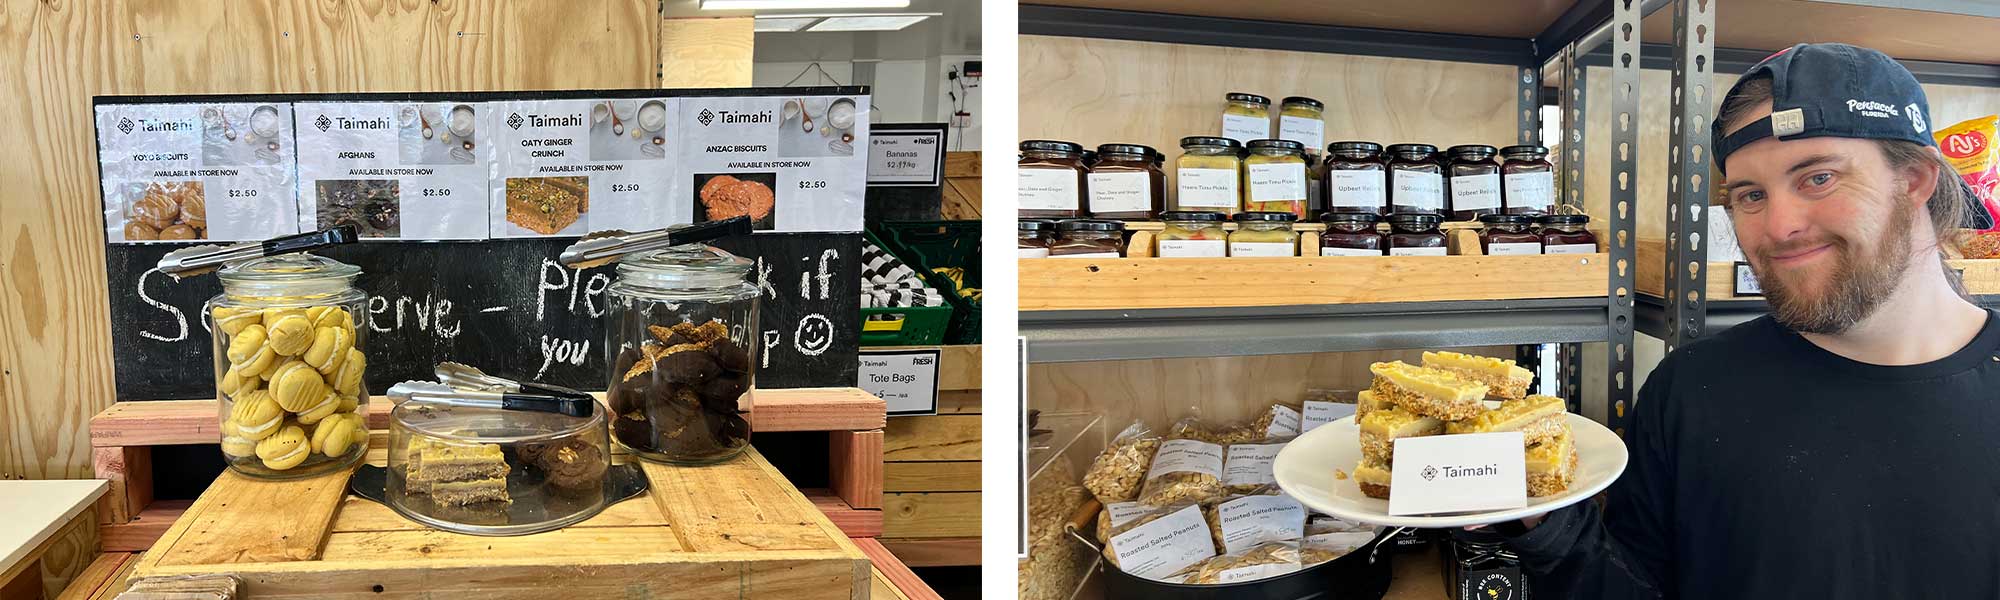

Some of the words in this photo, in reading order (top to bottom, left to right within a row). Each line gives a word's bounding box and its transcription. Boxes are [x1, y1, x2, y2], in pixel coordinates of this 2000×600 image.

[1846, 99, 1899, 116] Pensacola
[528, 114, 582, 127] Taimahi
[719, 110, 772, 123] Taimahi
[139, 118, 192, 132] Taimahi
[336, 117, 390, 130] Taimahi
[1949, 134, 1980, 154] AJ's
[612, 184, 639, 192] $2.50
[799, 180, 826, 189] $2.50
[228, 189, 257, 198] $2.50
[422, 188, 451, 197] $2.50
[801, 248, 840, 300] if
[533, 334, 590, 381] you
[869, 374, 889, 383] Tote
[892, 373, 916, 384] Bags
[1442, 464, 1497, 478] Taimahi
[1224, 512, 1251, 523] Roasted
[1120, 542, 1150, 559] Roasted
[1150, 533, 1173, 546] Salted
[1174, 523, 1200, 537] Peanuts
